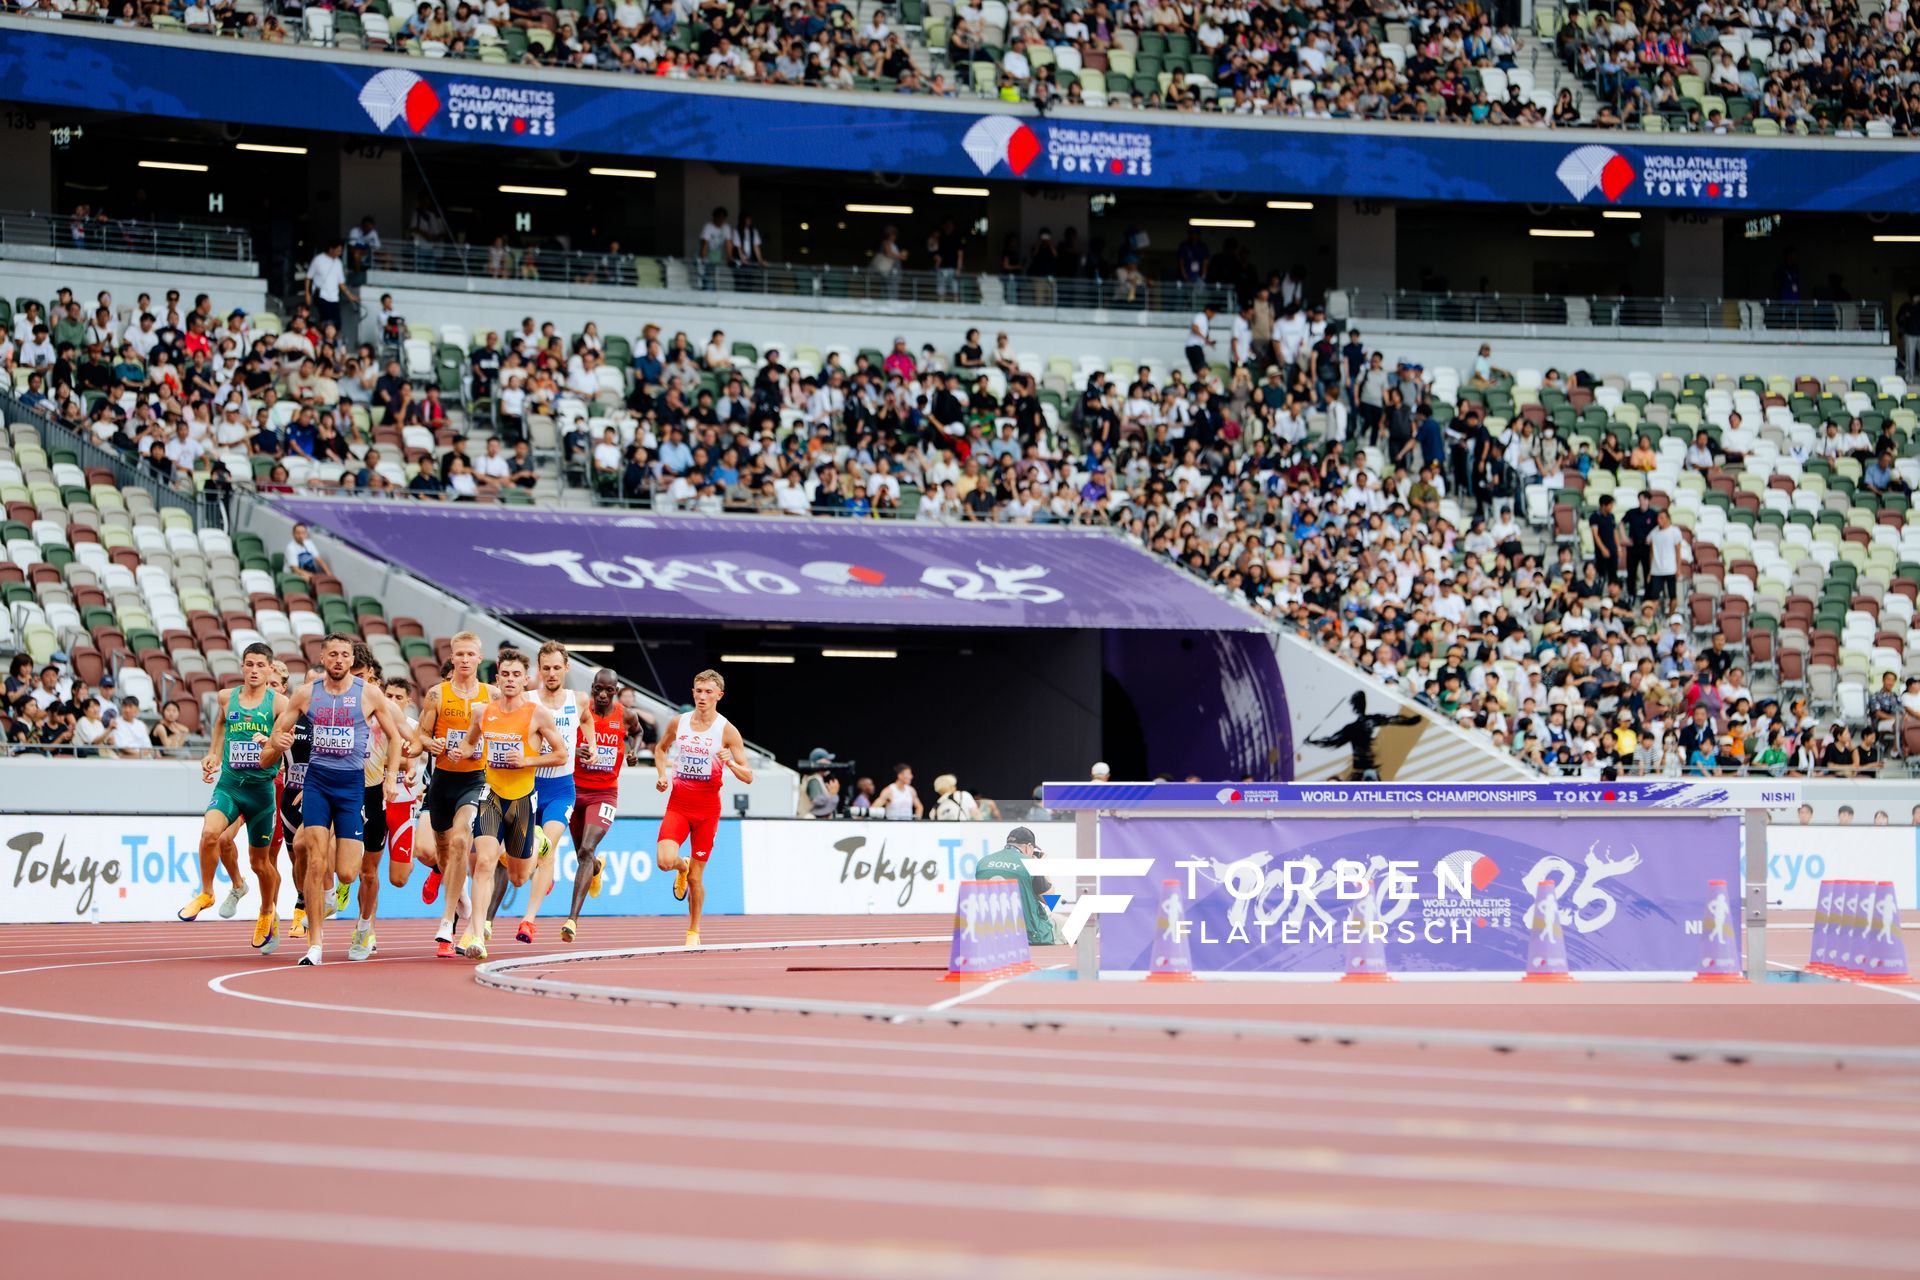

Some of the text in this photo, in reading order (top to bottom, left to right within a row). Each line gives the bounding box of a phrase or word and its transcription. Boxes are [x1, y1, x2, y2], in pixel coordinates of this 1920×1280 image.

[448, 83, 555, 105] WORLD ATHLETICS
[448, 97, 555, 120] CHAMPIONSHIPS
[529, 119, 555, 137] 25
[1048, 126, 1152, 149] WORLD ATHLETICS
[1048, 140, 1152, 162] CHAMPIONSHIPS
[1127, 160, 1152, 176] 25
[1644, 155, 1748, 171] WORLD ATHLETICS
[1643, 168, 1748, 184] CHAMPIONSHIPS
[1724, 183, 1748, 198] 25
[209, 192, 224, 213] H
[515, 211, 531, 232] H
[473, 546, 1065, 604] TOKYO 25
[315, 707, 351, 717] GREAT
[229, 721, 269, 733] AUSTRALIA
[324, 727, 351, 736] TDK
[315, 737, 352, 748] GOURLEY
[494, 742, 520, 751] TDK
[680, 744, 709, 756] POLSKA
[231, 752, 260, 761] MYER
[493, 752, 506, 762] BE
[686, 756, 709, 765] TDK
[684, 765, 703, 774] RAK
[1301, 791, 1348, 802] WORLD
[1353, 791, 1423, 802] ATHLETICS
[1427, 791, 1537, 802] CHAMPIONSHIPS
[1617, 791, 1638, 803] 25
[1761, 792, 1795, 802] NISHI
[603, 806, 613, 815] 11
[987, 860, 1021, 870] SONY
[6, 831, 120, 915] Tokyo
[833, 836, 937, 907] Tokyo
[1522, 839, 1644, 933] 25
[1422, 899, 1511, 908] WORLD ATHLETICS
[1422, 908, 1511, 917] CHAMPIONSHIPS
